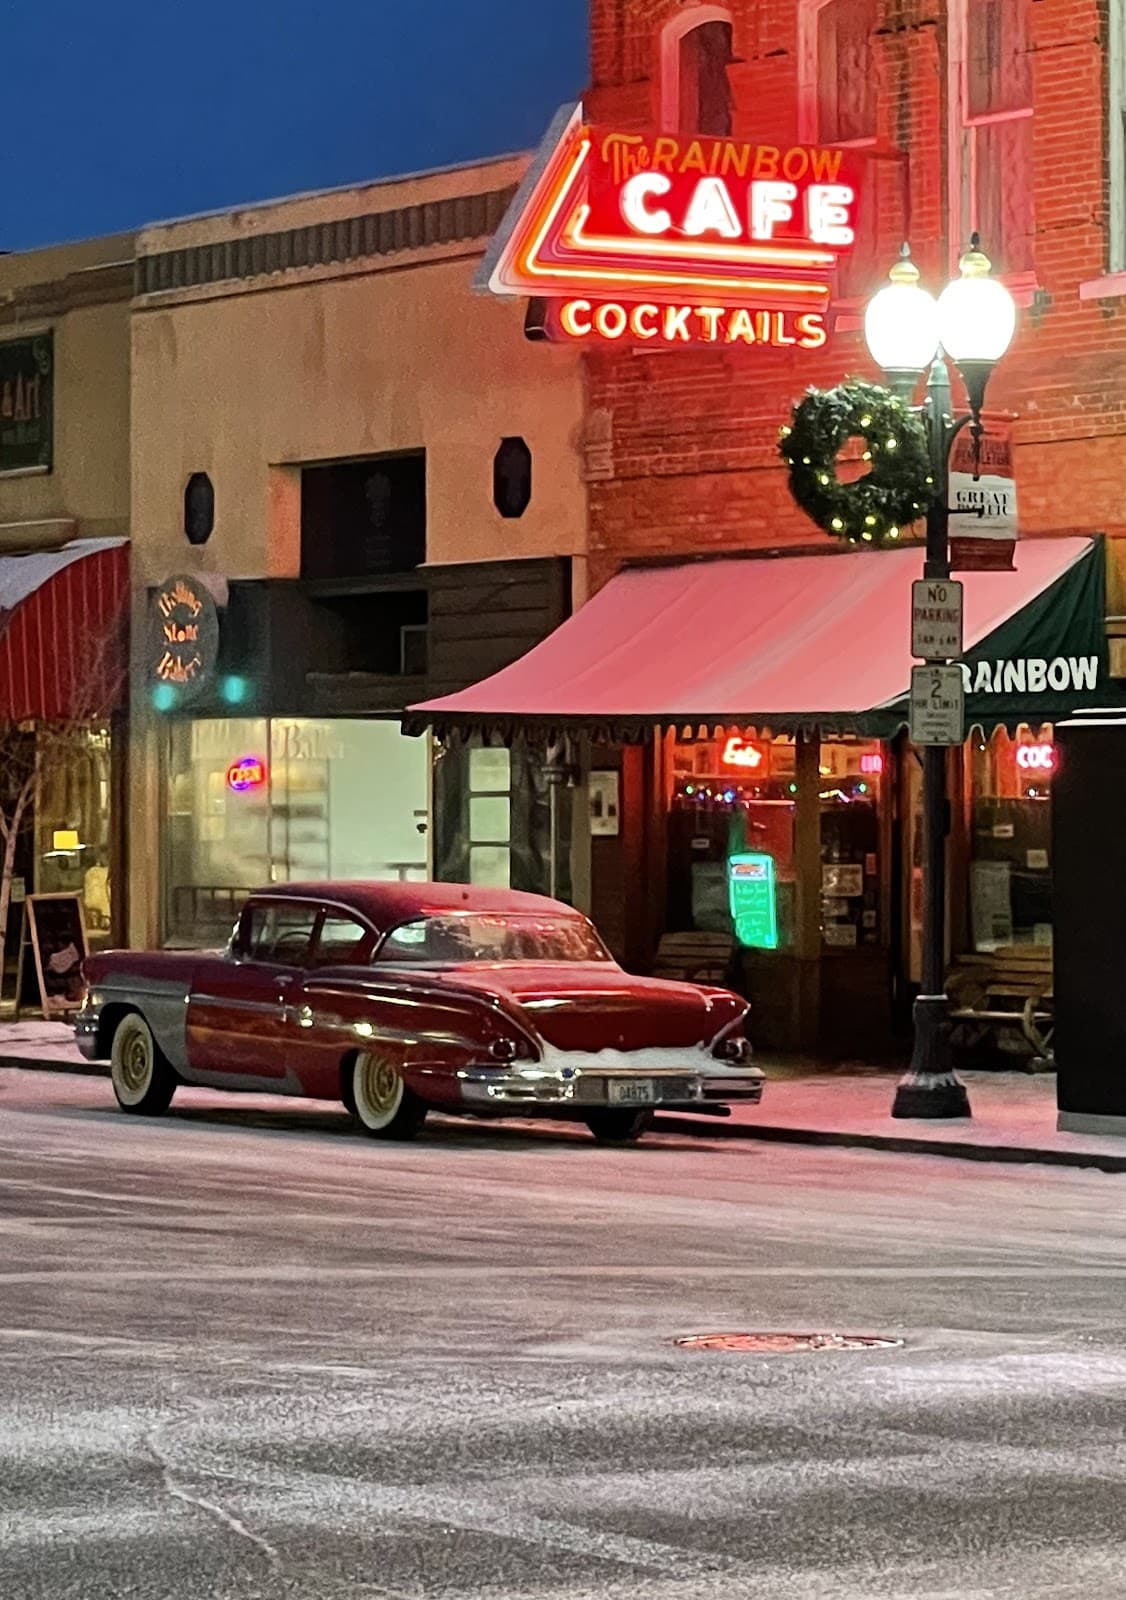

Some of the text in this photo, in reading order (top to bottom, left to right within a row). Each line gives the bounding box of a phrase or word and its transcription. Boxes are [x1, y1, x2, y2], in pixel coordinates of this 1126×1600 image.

[602, 133, 843, 184] The RAINBOW
[620, 172, 855, 246] CAFE
[560, 299, 828, 349] COCKTAILS
[956, 491, 1009, 504] GREAT
[928, 587, 947, 602] NO
[914, 607, 960, 623] PARKING
[950, 656, 1098, 693] RAINBOW
[931, 680, 942, 698] 2
[229, 764, 262, 786] OPEN
